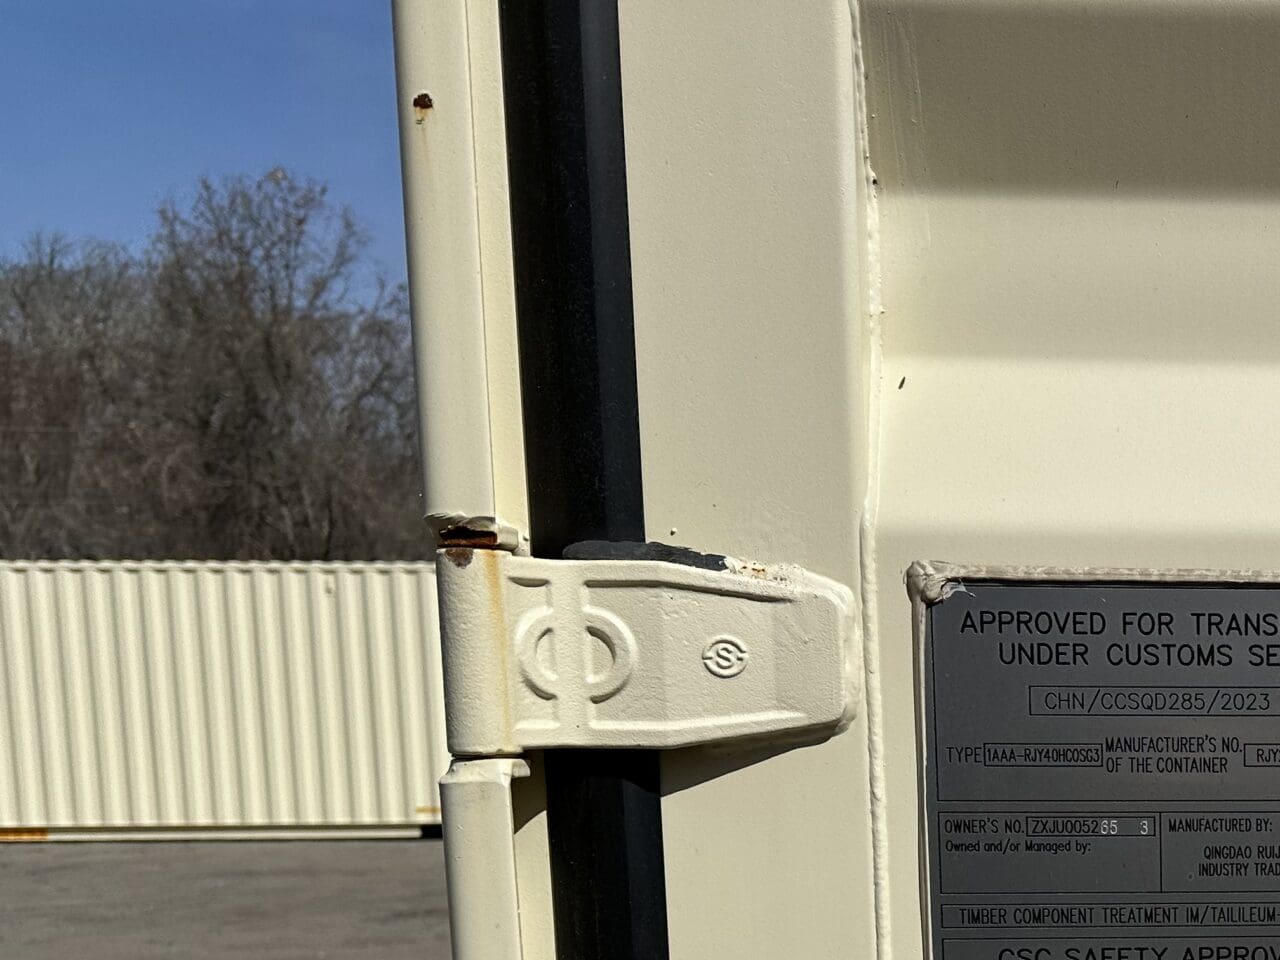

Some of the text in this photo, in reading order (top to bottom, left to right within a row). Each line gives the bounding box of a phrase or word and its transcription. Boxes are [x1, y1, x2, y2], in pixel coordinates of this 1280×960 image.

[960, 611, 1107, 636] APPROVED
[1122, 612, 1175, 636] FOR
[998, 642, 1089, 666] UNDER
[1106, 643, 1233, 667] CUSTOMS
[1044, 689, 1271, 715] CHN/CCSQD285/2023
[1104, 735, 1243, 754] MANUFACTURER'S NO.
[946, 746, 983, 764] TYPE
[1106, 756, 1228, 774] OF THE CONTAINER
[944, 818, 999, 834] OWNER'S
[1004, 819, 1025, 834] NO.
[1168, 818, 1273, 832] MANUFACTURED BY:
[945, 838, 1092, 855] Owned and/or Managed by:
[1203, 846, 1252, 860] QINGDAO
[1198, 862, 1250, 877] INDUSTRY
[959, 908, 1007, 925] TIMBER
[1013, 908, 1095, 924] COMPONENT
[1102, 907, 1180, 924] TREATMENT
